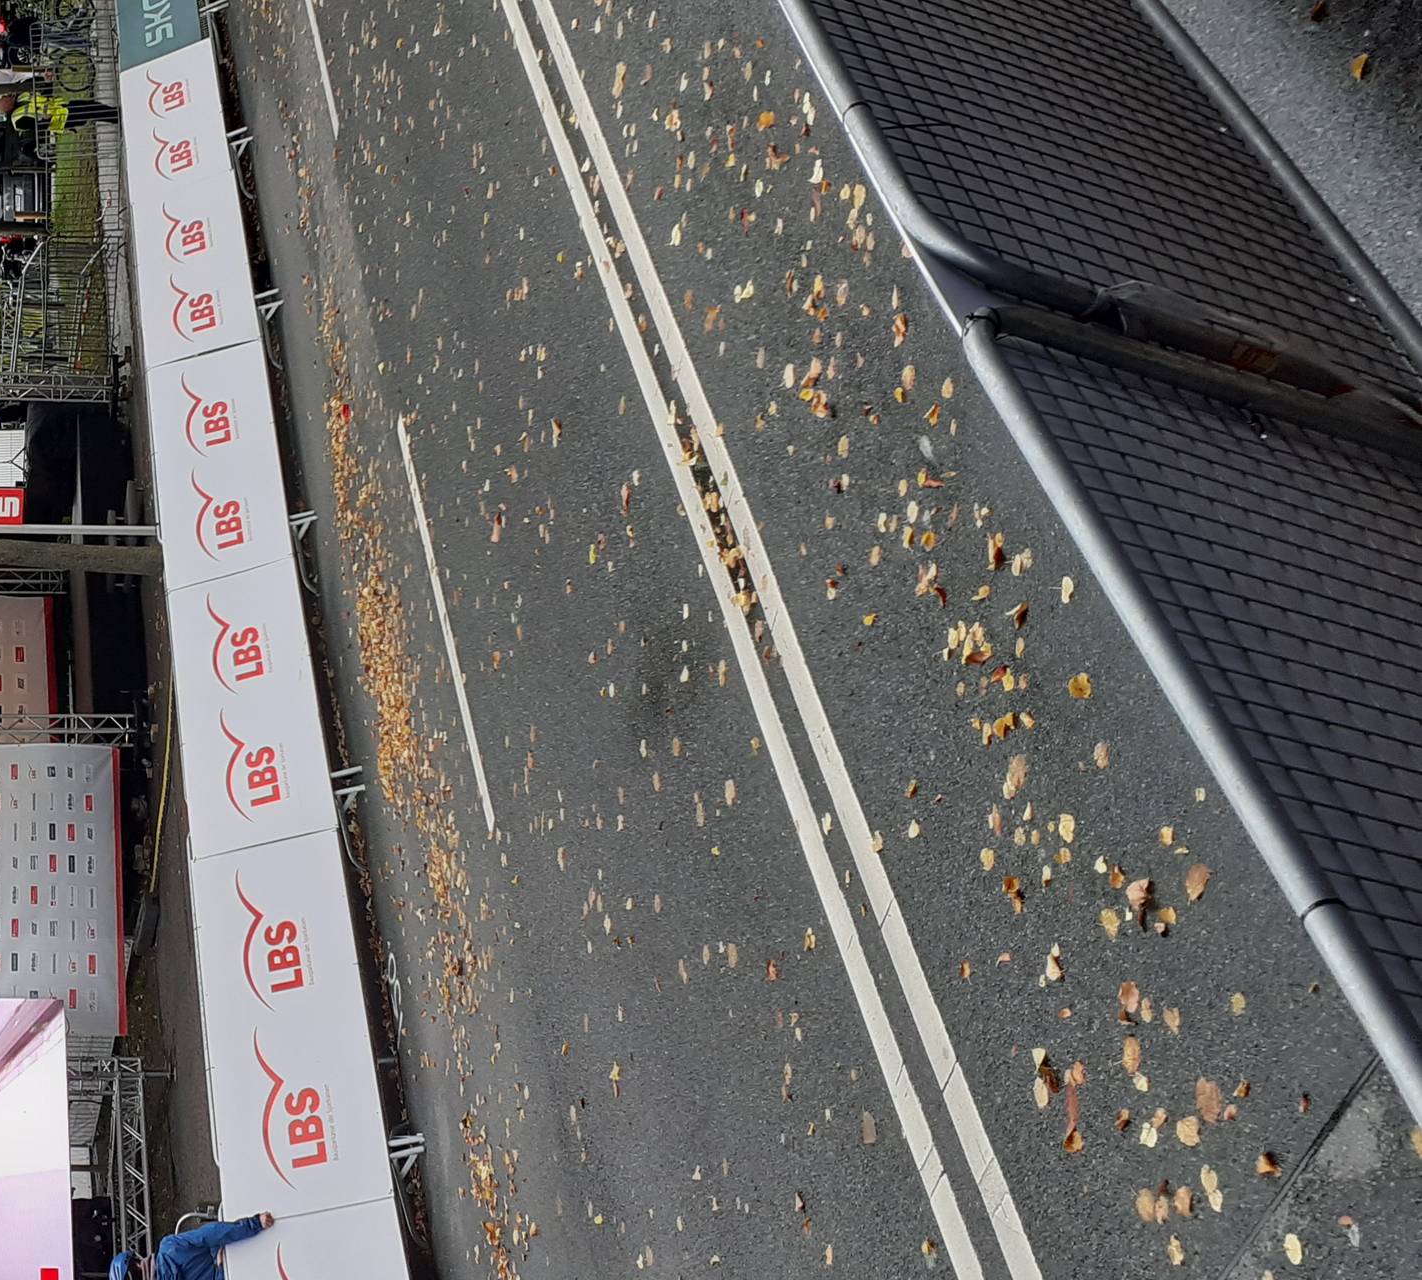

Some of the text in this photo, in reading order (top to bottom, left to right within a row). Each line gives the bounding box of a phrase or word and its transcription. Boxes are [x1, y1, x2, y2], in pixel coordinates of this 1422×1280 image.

[162, 81, 185, 112] LBS
[169, 140, 193, 173] LBS
[180, 220, 206, 256] LBS
[188, 293, 216, 333] LBS
[202, 400, 232, 447] LBS
[213, 500, 244, 550] LBS
[230, 626, 264, 682] LBS
[244, 746, 280, 807] LBS
[264, 920, 304, 993] LBS
[284, 1088, 328, 1168] LBS
